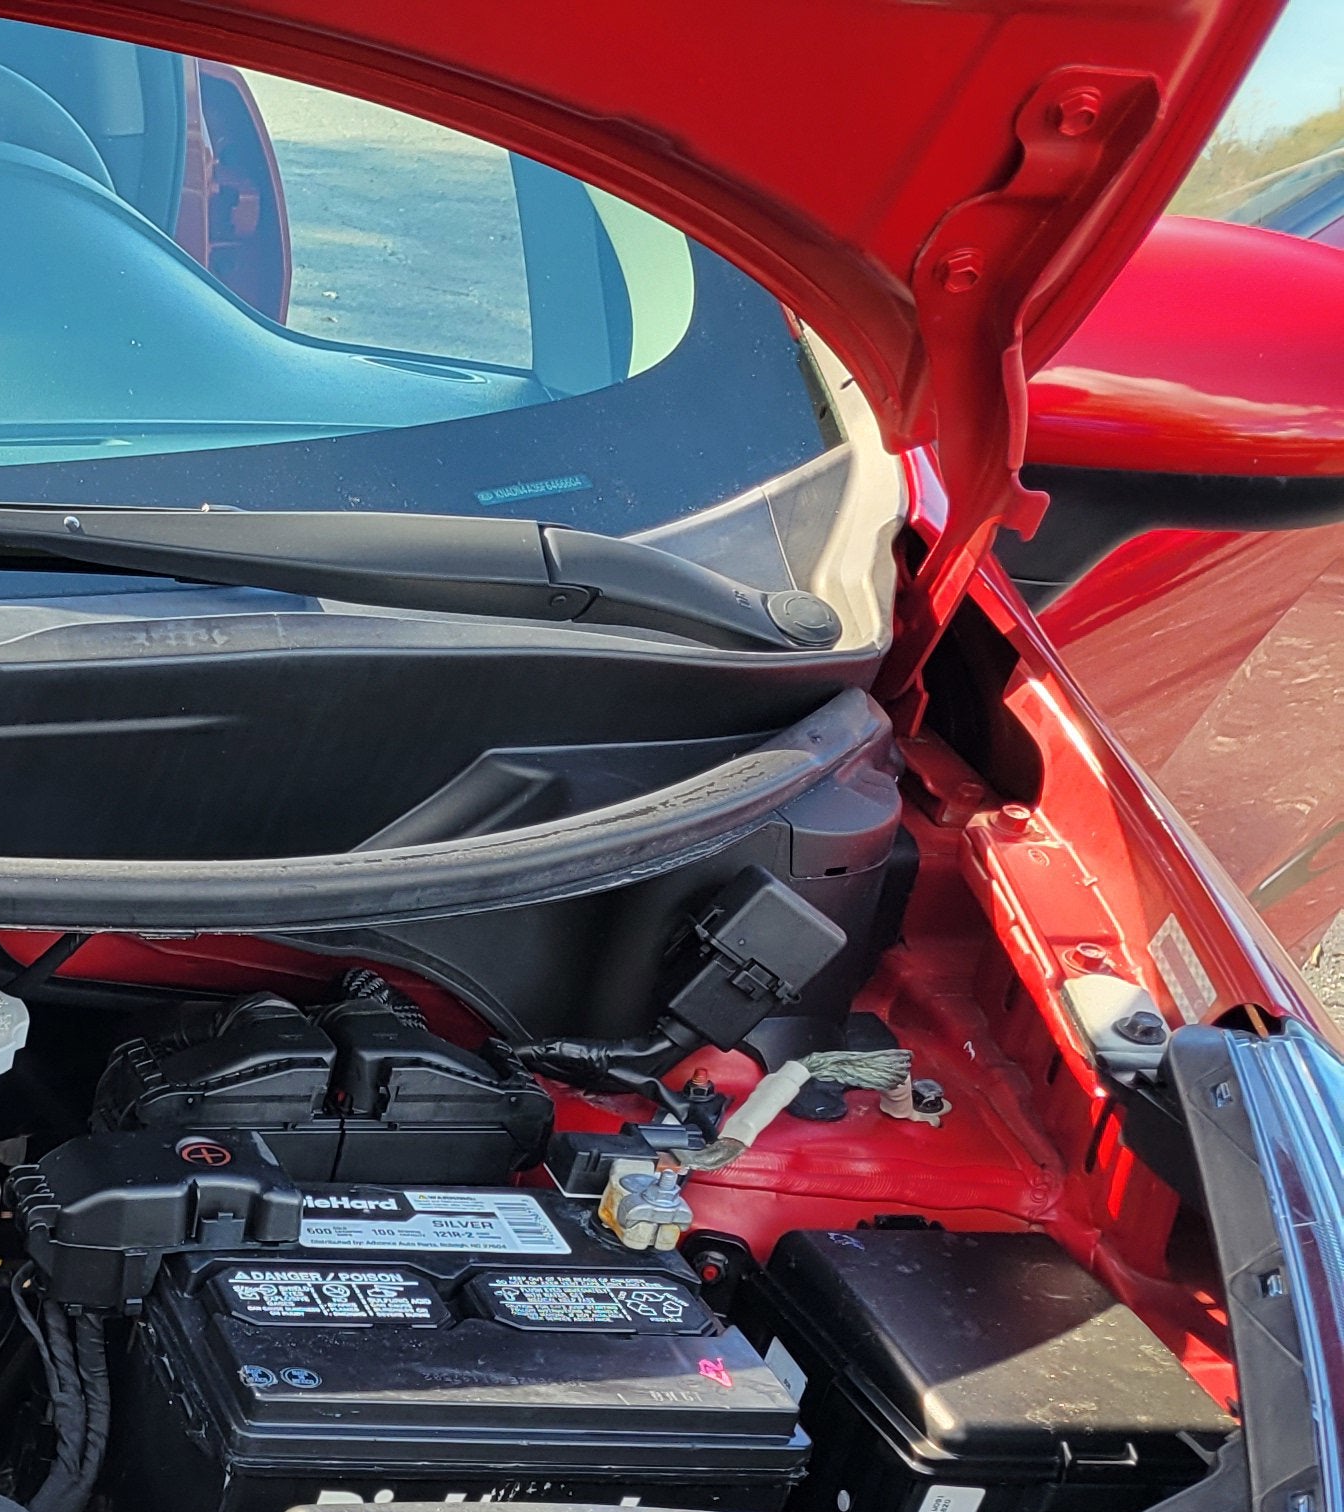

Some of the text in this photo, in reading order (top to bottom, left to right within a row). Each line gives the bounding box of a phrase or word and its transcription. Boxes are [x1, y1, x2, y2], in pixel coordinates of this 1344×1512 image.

[431, 1219, 493, 1230] SILVER
[371, 1228, 395, 1236] 100
[250, 1271, 322, 1281] DANGER
[338, 1272, 404, 1282] POISON
